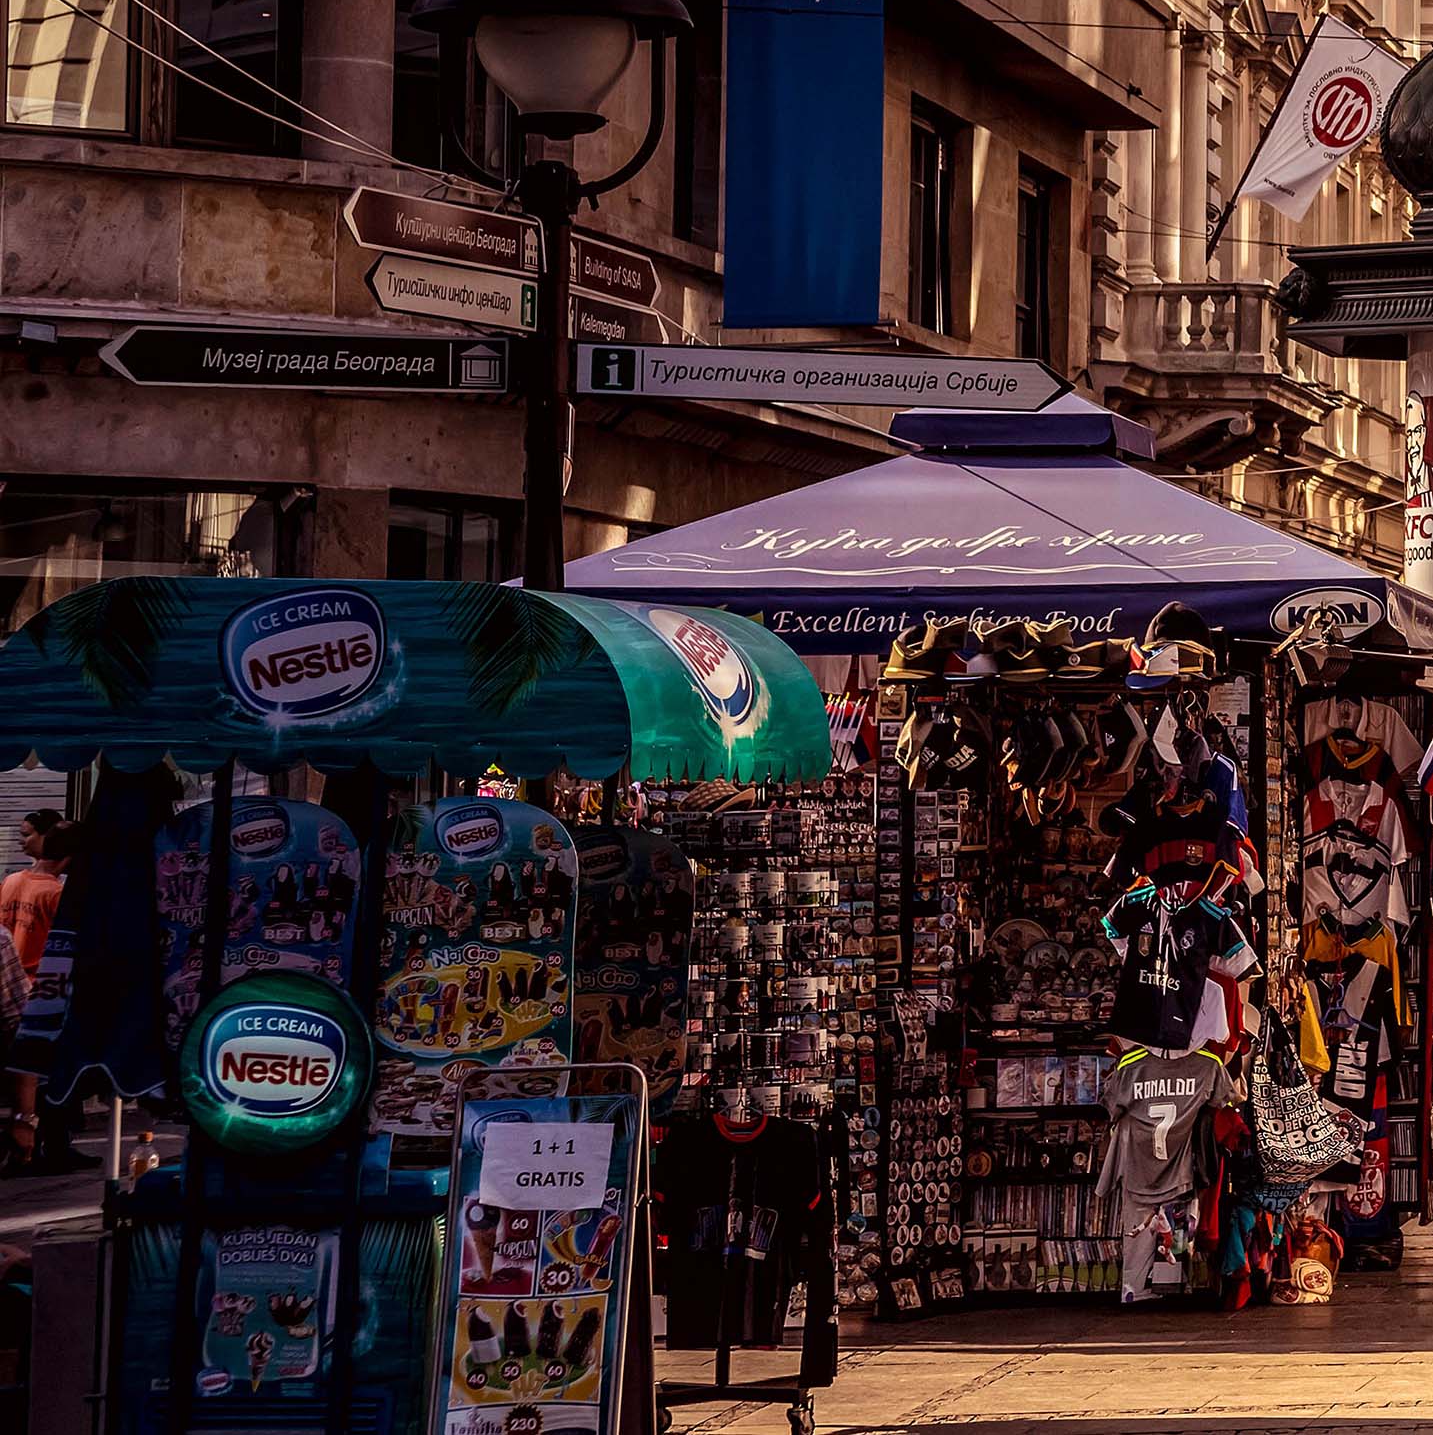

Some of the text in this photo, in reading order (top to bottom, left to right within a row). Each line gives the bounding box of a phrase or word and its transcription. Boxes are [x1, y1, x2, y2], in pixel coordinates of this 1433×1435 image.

[476, 228, 518, 255] Београда
[584, 256, 642, 291] Building of SASA
[580, 312, 627, 342] Kalemegdan
[202, 347, 436, 376] Музеј града Београда
[650, 359, 1019, 396] Туристичка организација Србије
[252, 600, 353, 634] ICE CREAM
[772, 607, 909, 634] Excellent
[248, 633, 373, 691] Nestlé
[483, 926, 525, 939] BEST
[237, 1017, 324, 1038] ICE CREAM
[221, 1052, 331, 1086] Nestlé
[1133, 1077, 1196, 1100] RONALDO
[1149, 1102, 1177, 1161] 7
[532, 1139, 576, 1155] 1 + 1
[516, 1171, 585, 1187] GRATIS
[511, 1217, 529, 1231] 60
[222, 1229, 318, 1249] KUPIŠ JEDAN
[279, 1249, 315, 1267] DVA!
[545, 1270, 571, 1286] 30
[468, 1373, 486, 1385] 40
[503, 1365, 520, 1377] 50
[547, 1365, 564, 1376] 60
[509, 1419, 537, 1431] 230
